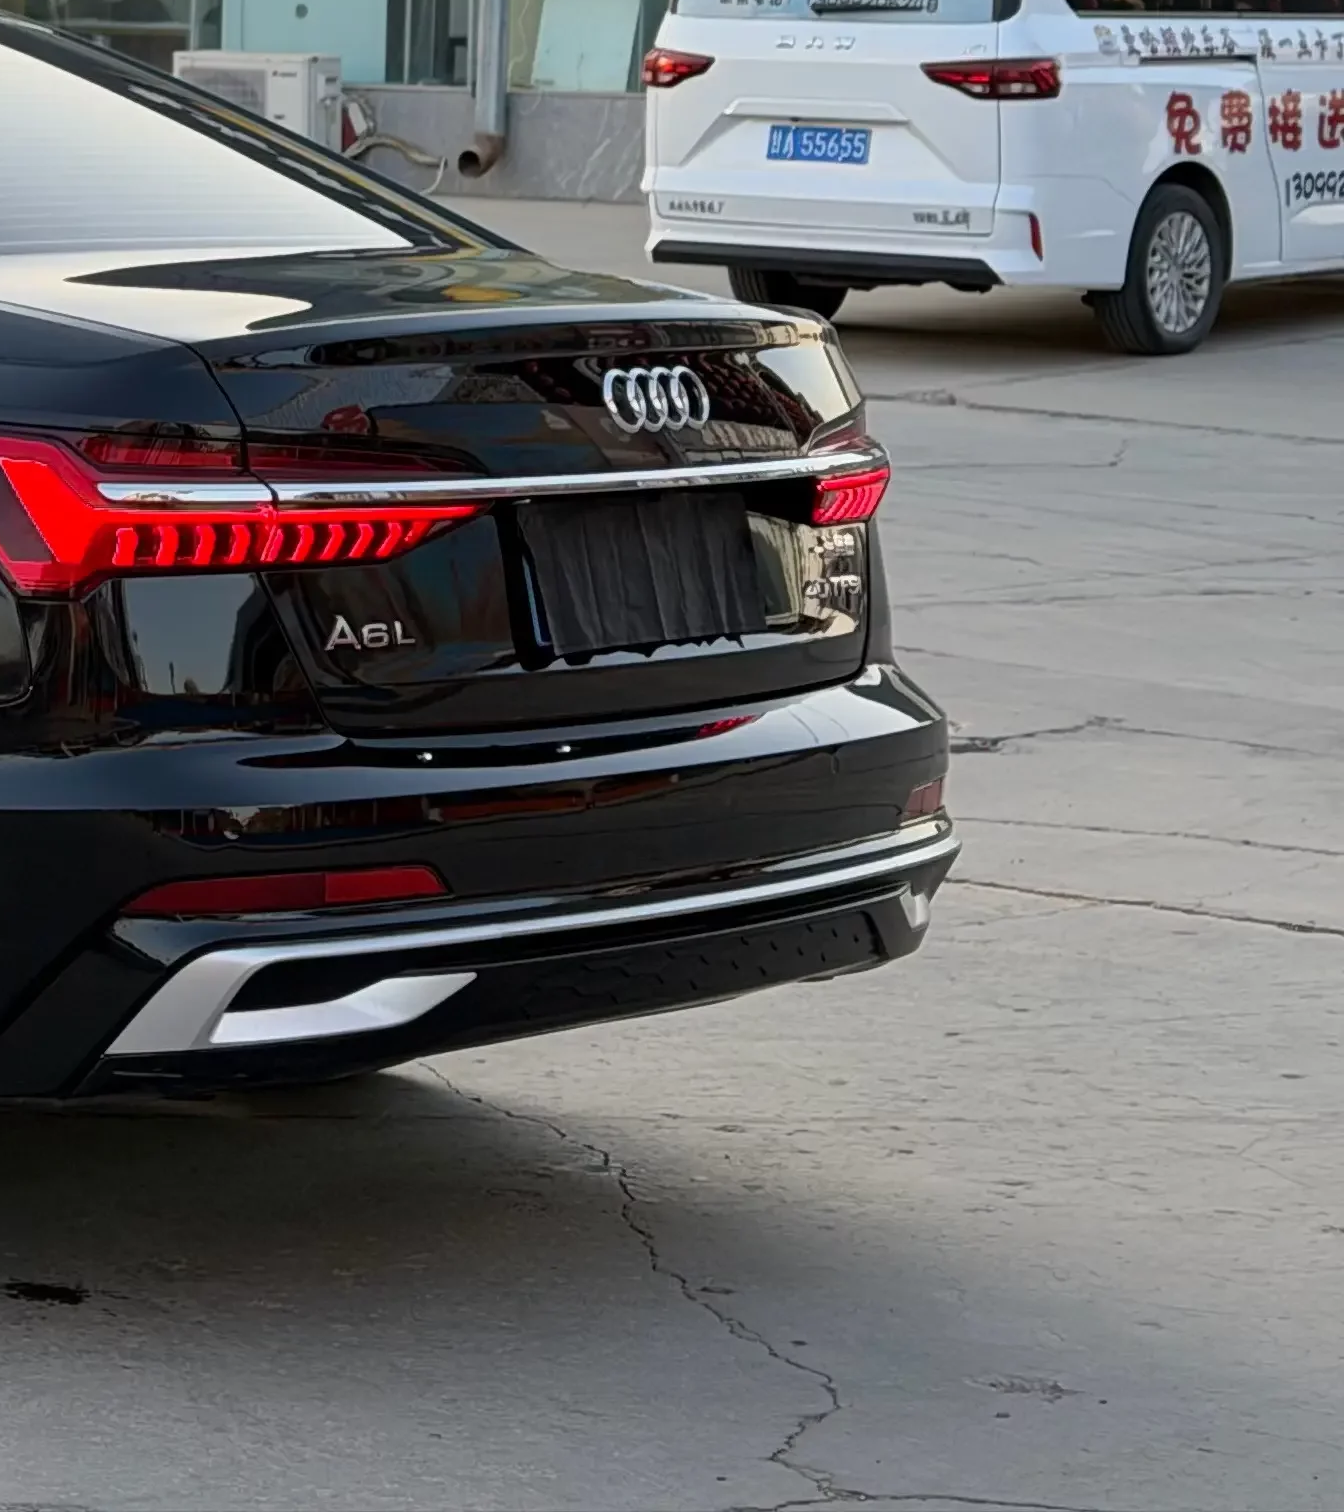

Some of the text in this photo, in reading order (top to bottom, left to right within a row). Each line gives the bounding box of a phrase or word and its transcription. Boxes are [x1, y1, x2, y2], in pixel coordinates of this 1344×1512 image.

[1165, 88, 1344, 155] 免费接送
[324, 614, 416, 650] A6L
